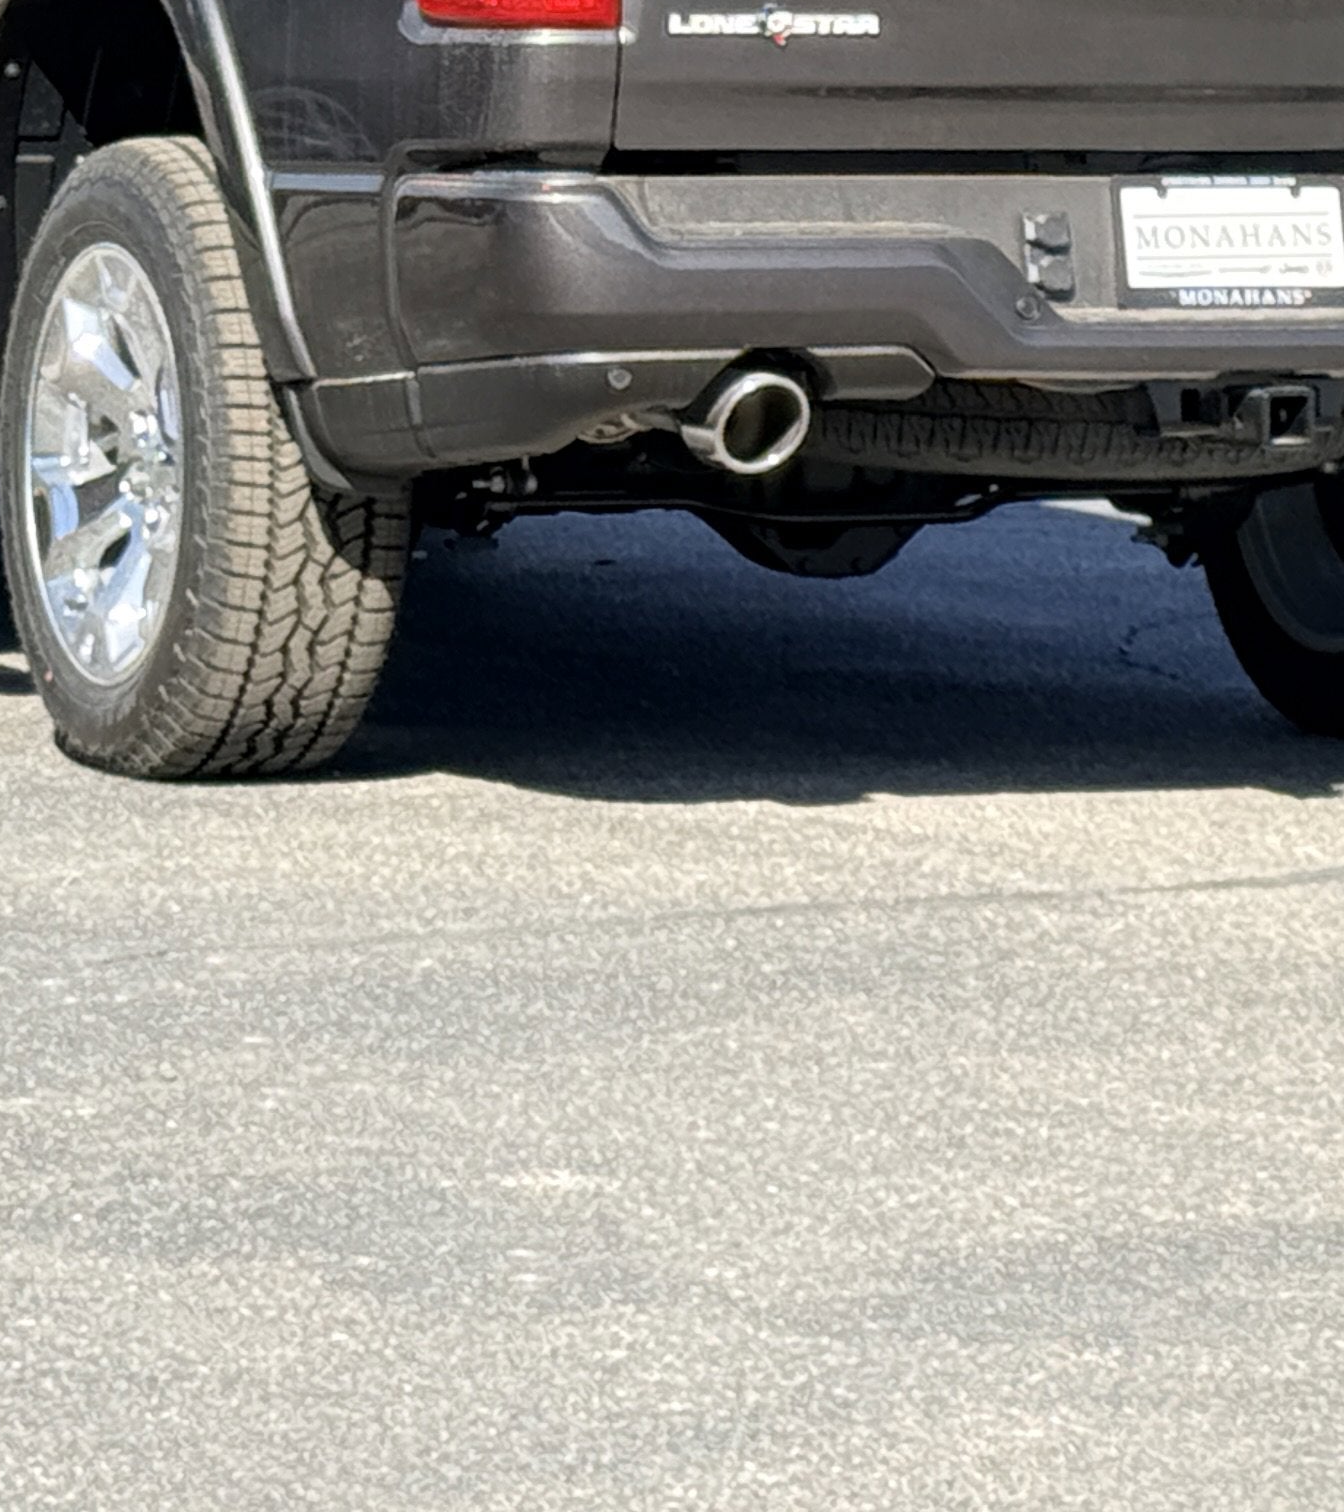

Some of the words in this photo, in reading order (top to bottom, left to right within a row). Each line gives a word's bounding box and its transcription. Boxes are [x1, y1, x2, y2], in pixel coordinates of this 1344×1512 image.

[667, 12, 758, 35] LONE
[790, 12, 881, 35] STAR
[1135, 222, 1333, 251] MONAHANS
[1178, 289, 1306, 306] MONAHANS
